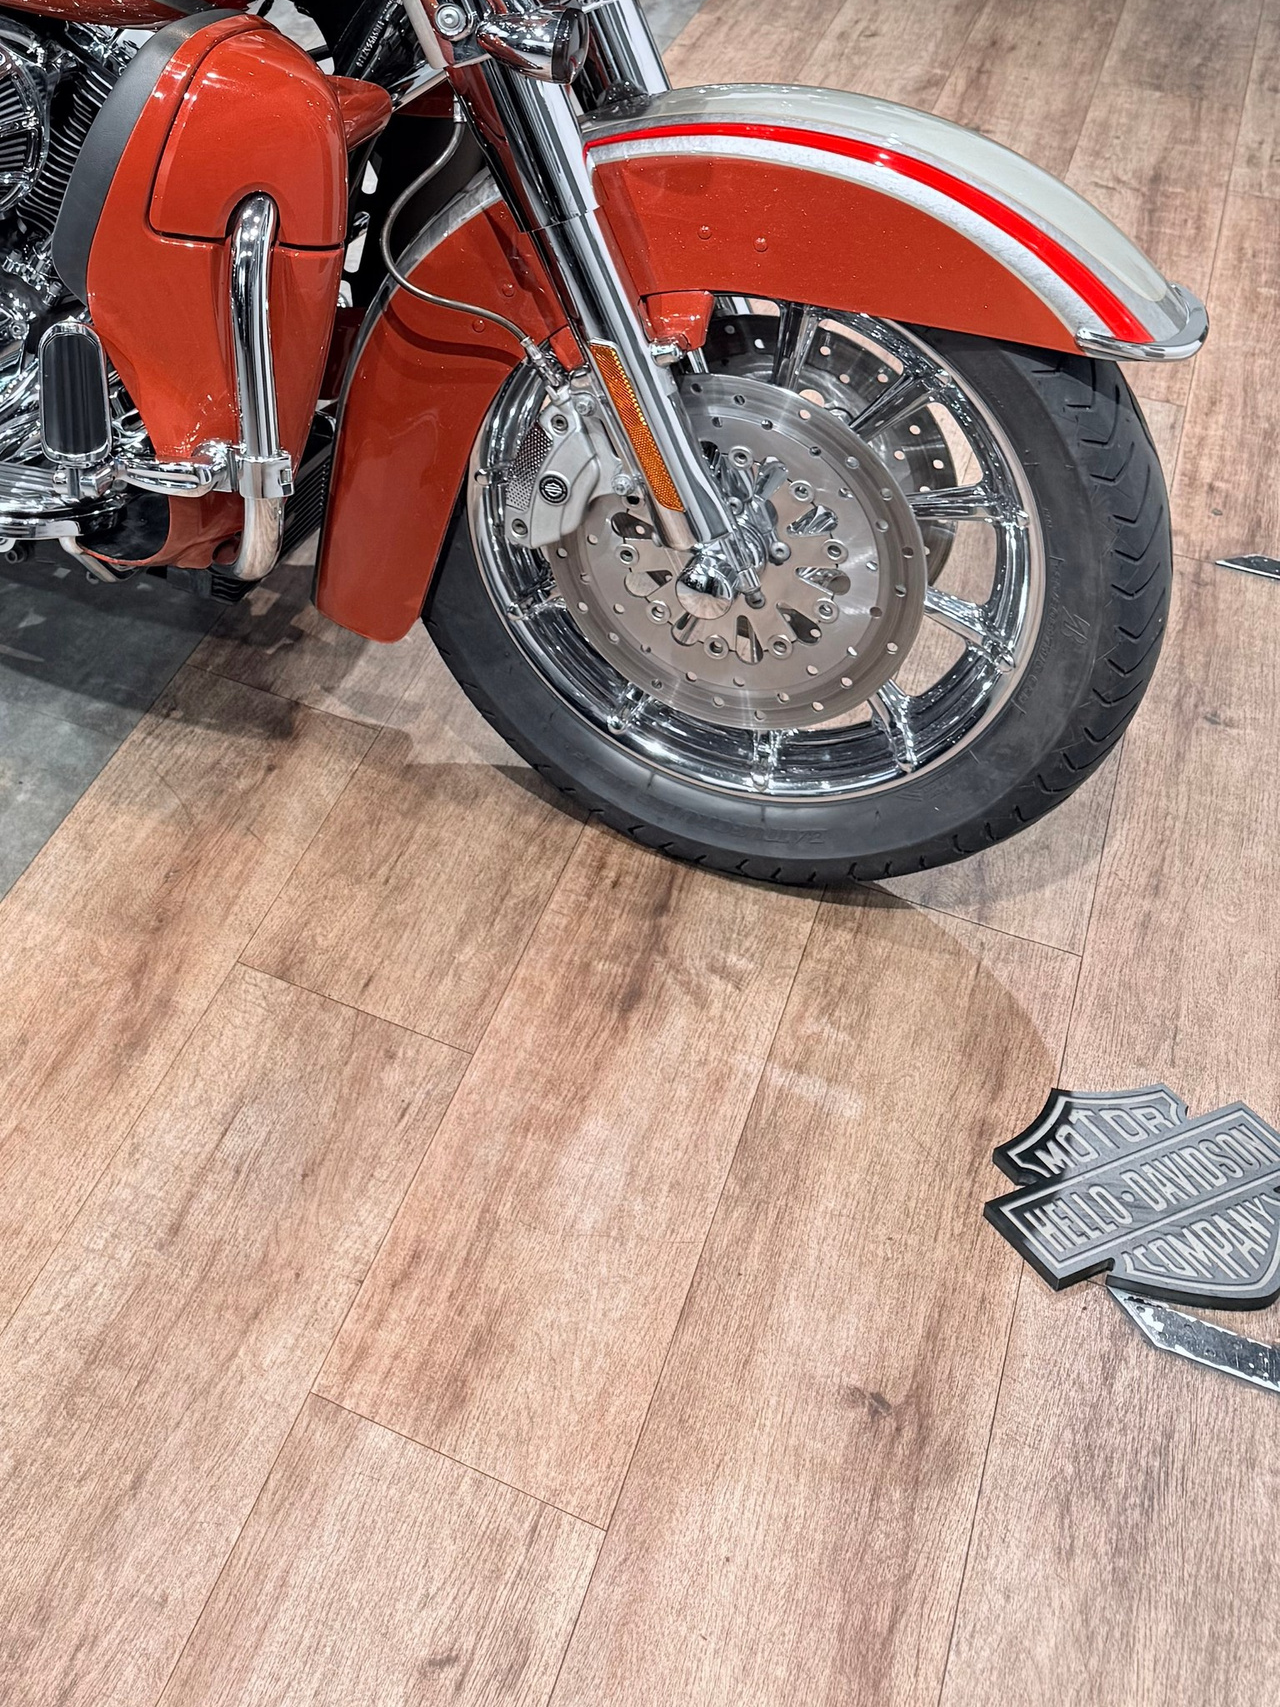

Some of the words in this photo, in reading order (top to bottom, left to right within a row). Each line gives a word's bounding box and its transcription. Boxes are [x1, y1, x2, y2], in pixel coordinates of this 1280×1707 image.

[1034, 1107, 1171, 1175] MOTOR
[1023, 1185, 1133, 1253] HELLO
[1123, 1123, 1274, 1212] DAVIDSON
[1135, 1192, 1275, 1280] COMPANY
